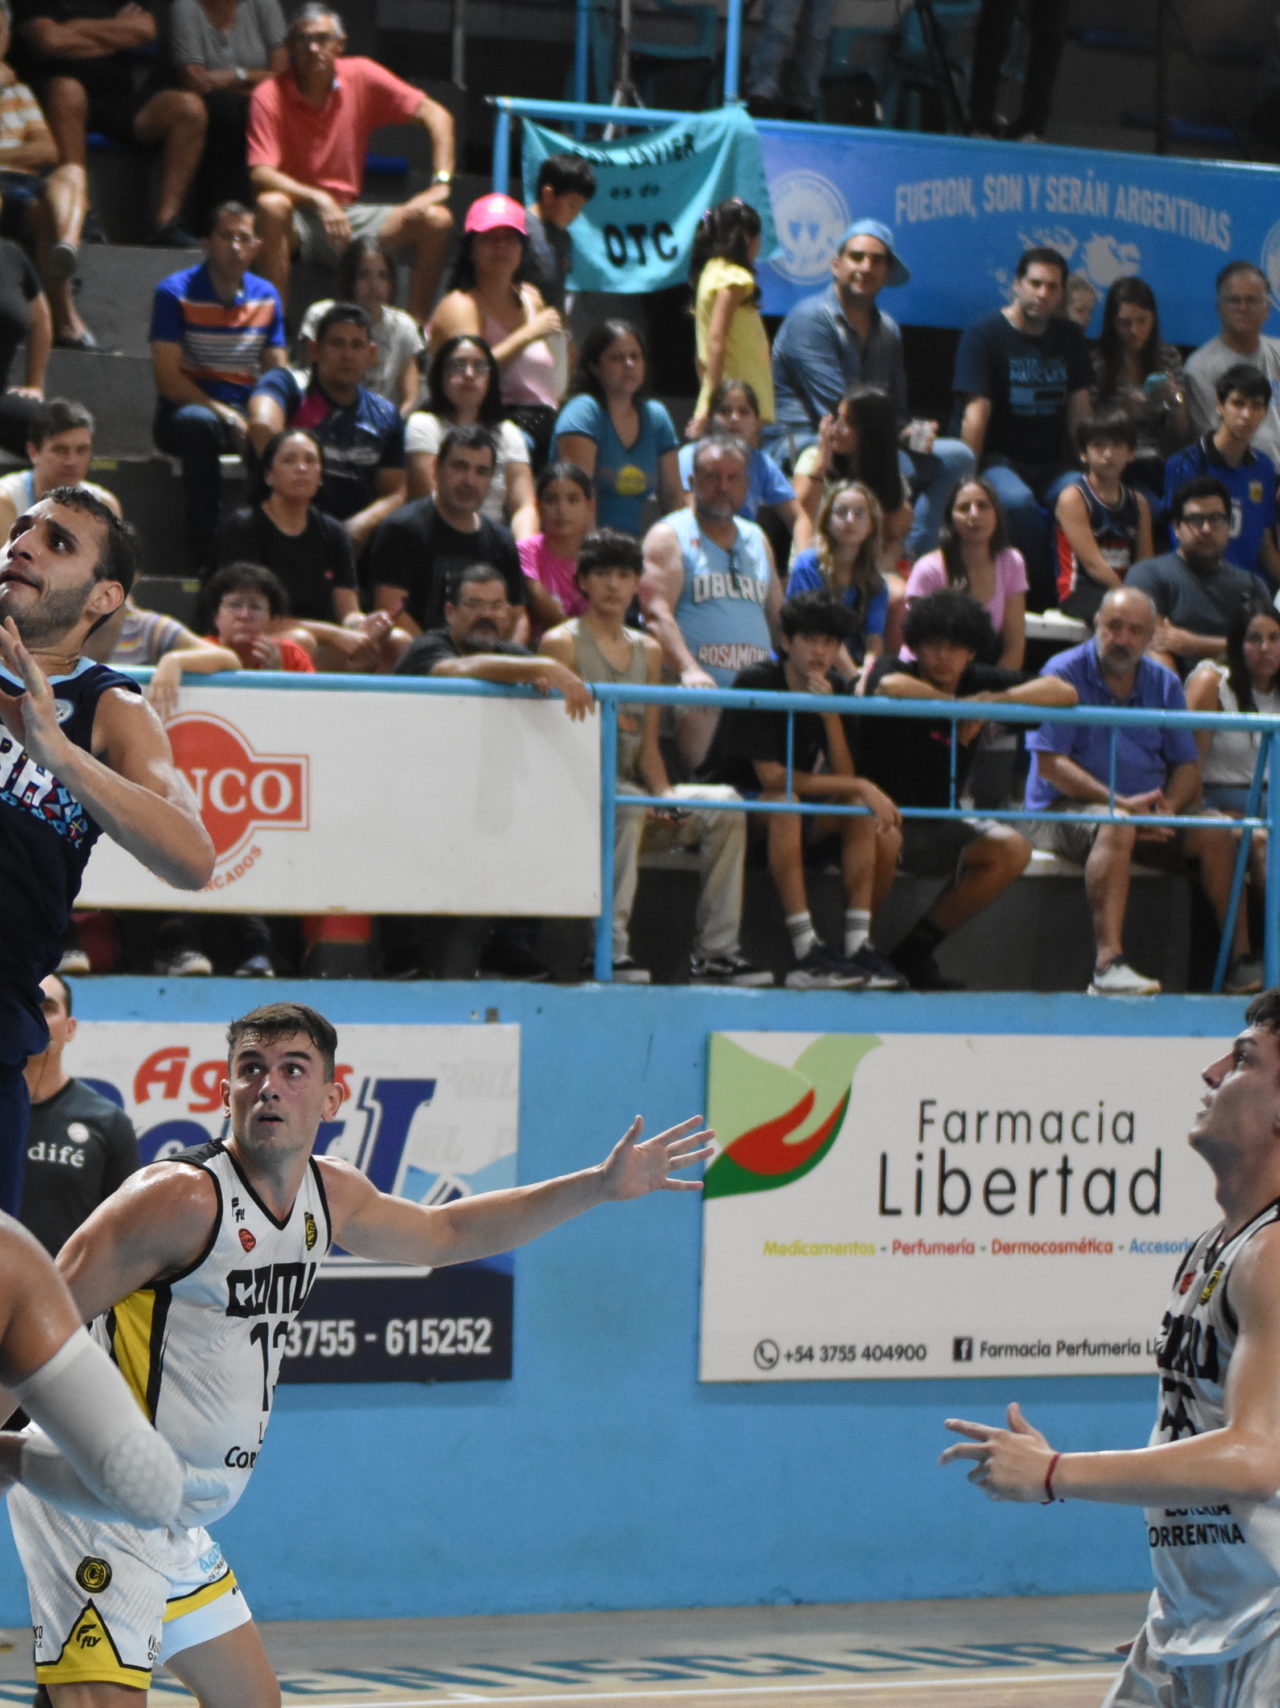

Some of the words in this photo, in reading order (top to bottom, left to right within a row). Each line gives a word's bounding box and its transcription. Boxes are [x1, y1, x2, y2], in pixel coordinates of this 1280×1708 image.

[896, 178, 977, 225] FUERON,
[983, 174, 1024, 213] SON
[1028, 174, 1041, 212] Y
[1113, 184, 1231, 252] ARGENTINAS
[604, 221, 678, 269] OTC
[919, 1098, 1135, 1144] Farmacia
[878, 1147, 1162, 1216] Libertad
[763, 1239, 876, 1256] Medicamentos
[892, 1238, 976, 1256] Perfumería
[991, 1237, 1114, 1255] Dermocosmética
[385, 1318, 492, 1355] 615252
[784, 1345, 815, 1362] +54
[820, 1345, 856, 1362] 3755
[861, 1344, 927, 1361] 404900
[980, 1339, 1051, 1358] Farmacia
[1148, 1522, 1247, 1548] ORRENTINA
